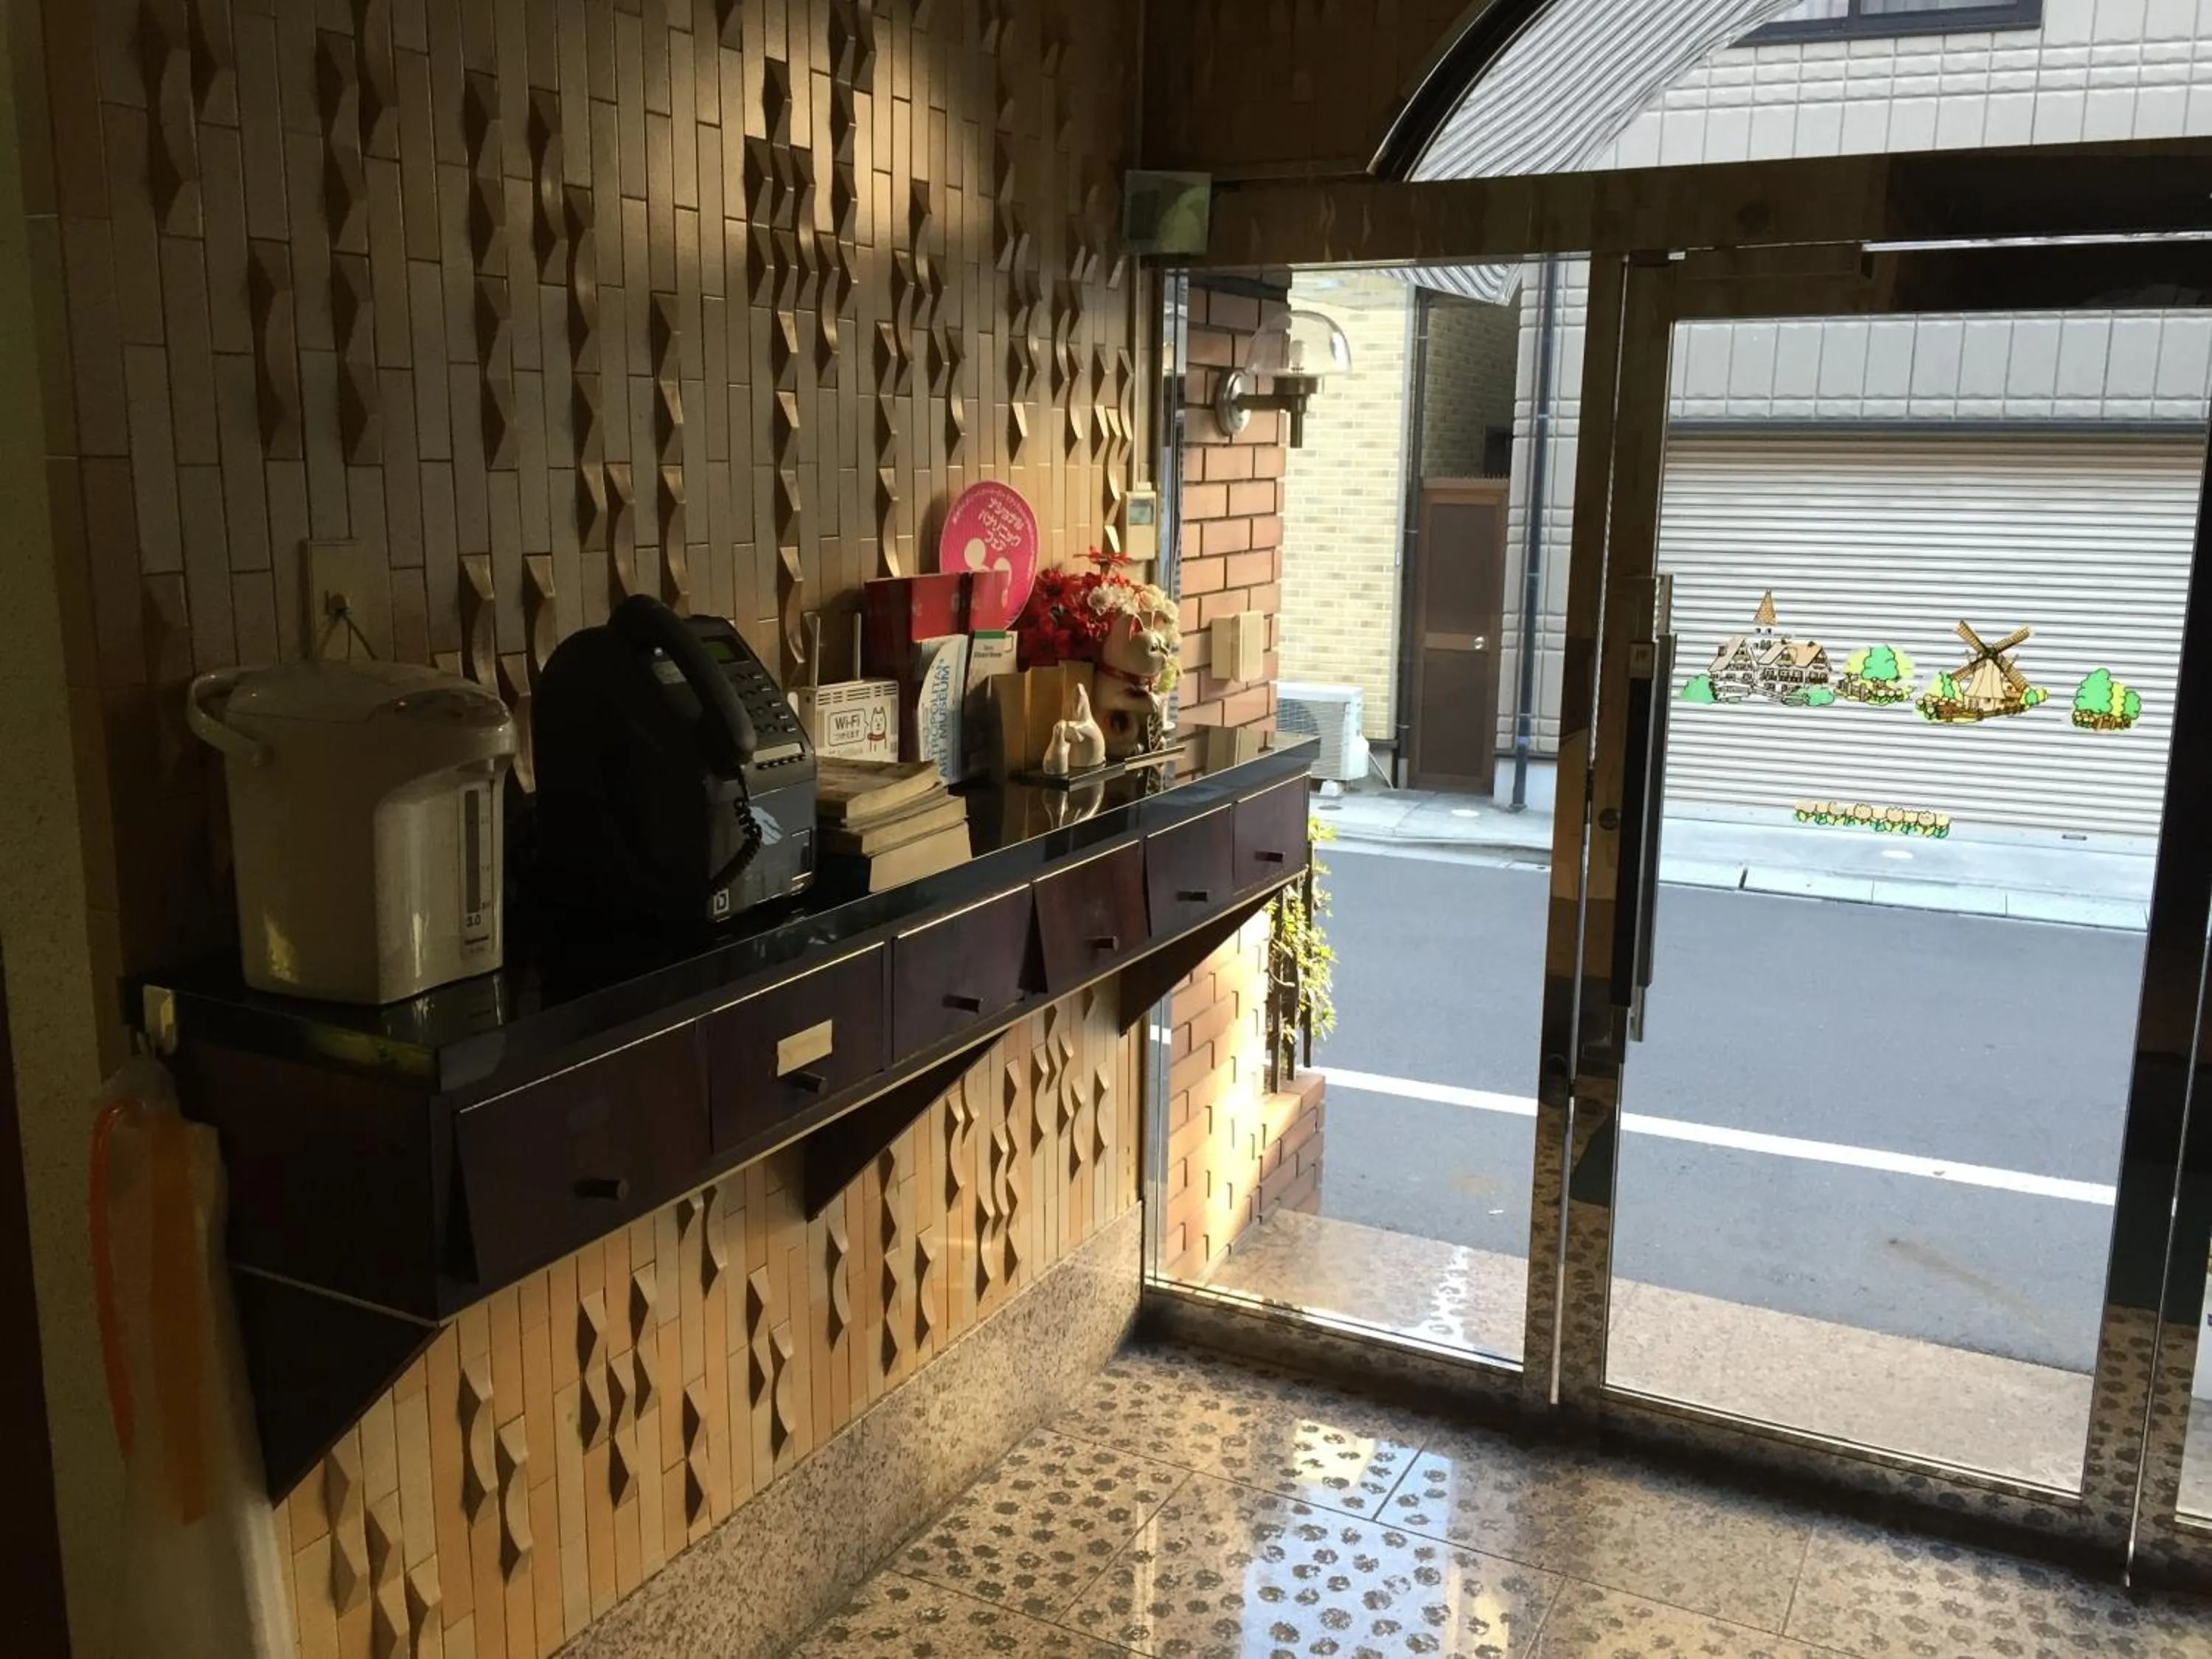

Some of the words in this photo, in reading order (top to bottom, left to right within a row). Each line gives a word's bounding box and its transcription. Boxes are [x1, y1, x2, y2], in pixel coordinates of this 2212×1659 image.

[938, 665, 950, 739] MUSEUM
[835, 714, 860, 731] Wi-Fi
[939, 748, 947, 777] ART
